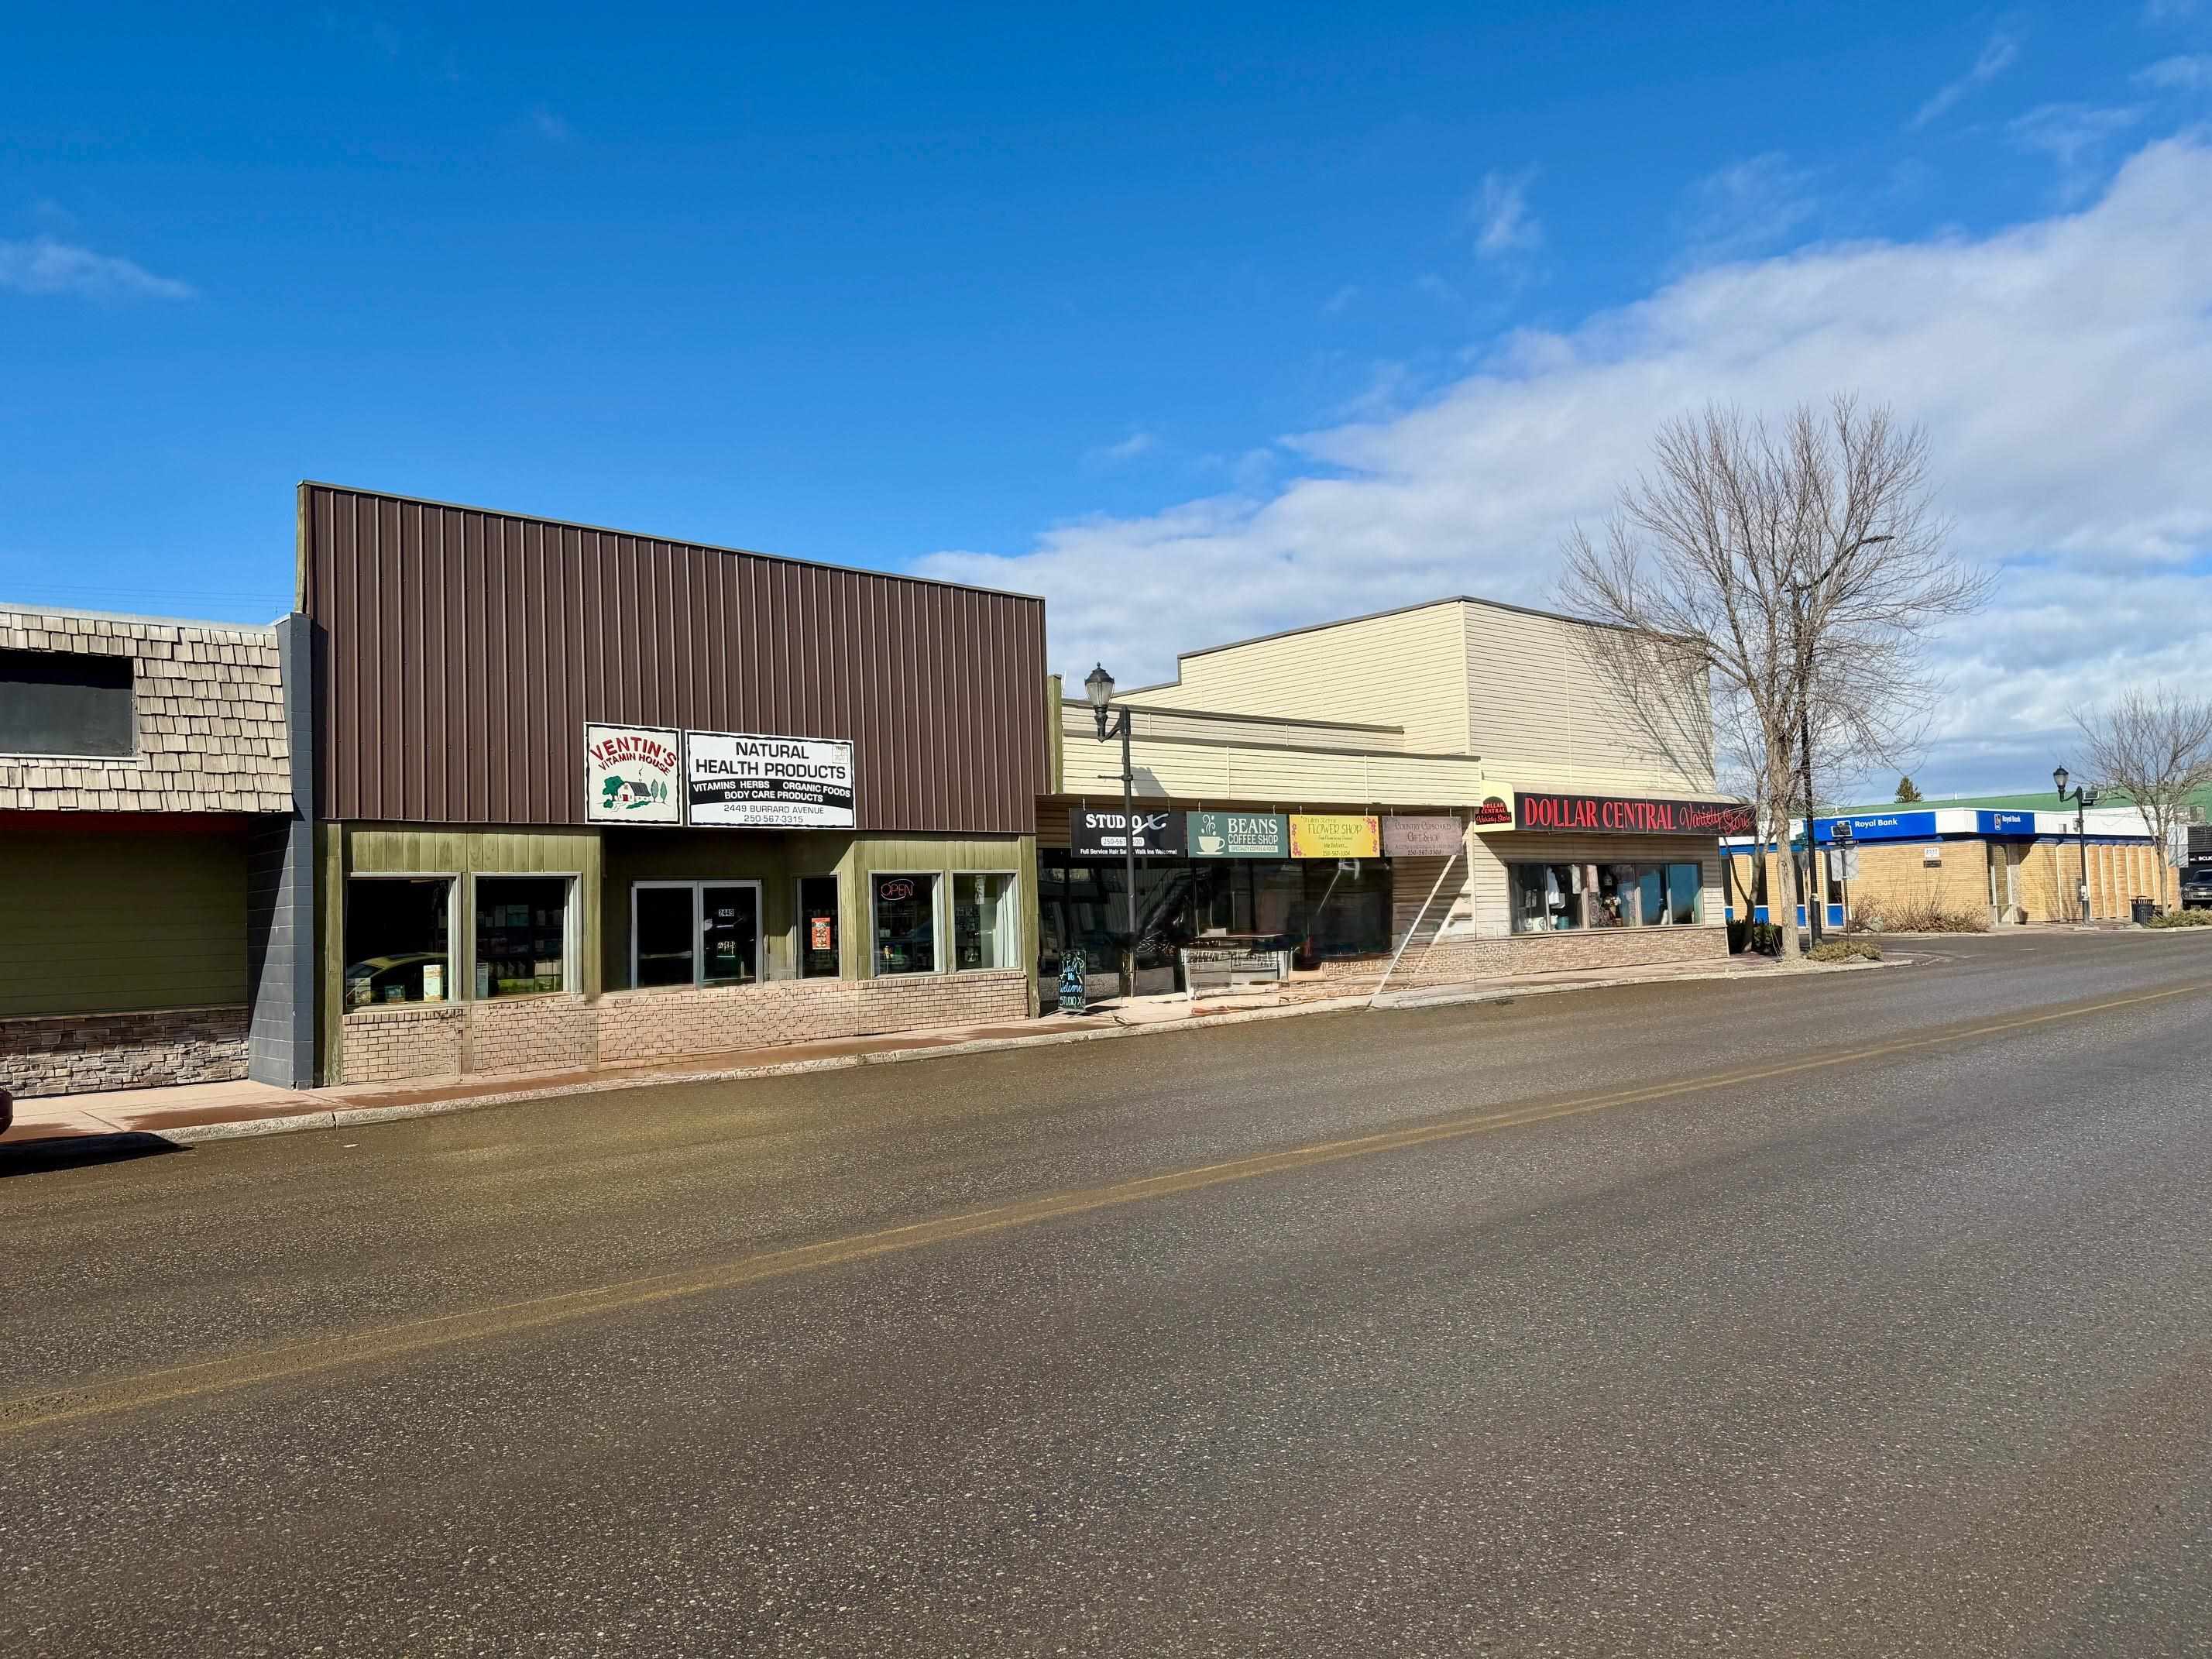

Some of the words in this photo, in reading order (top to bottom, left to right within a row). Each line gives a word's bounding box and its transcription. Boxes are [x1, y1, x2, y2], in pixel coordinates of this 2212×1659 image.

[589, 737, 677, 767] VENTIN'S
[736, 742, 809, 759] NATURAL
[598, 752, 636, 771] VITAMIN
[638, 754, 671, 776] HOUSE
[696, 758, 759, 775] HEALTH
[764, 763, 846, 779] PRODUCTS
[692, 781, 736, 792] VITAMINS
[782, 781, 822, 792] ORGANIC
[823, 785, 851, 798] FOODS
[724, 790, 750, 799] BODY
[751, 790, 775, 799] CARE
[777, 791, 823, 802] PRODUCTS
[1085, 813, 1142, 829] STUDO
[1524, 797, 1599, 828] DOLLAR
[1602, 801, 1677, 830] CENTRAL
[1679, 802, 1721, 830] Variety
[1228, 818, 1278, 834] BEANS
[1308, 823, 1340, 834] FLOWER
[1341, 824, 1362, 834] SHOP
[1855, 819, 1876, 829] Royal
[1877, 818, 1898, 826] Bank
[1228, 833, 1257, 844] COFFEE
[1258, 834, 1278, 845] SHOP
[881, 883, 913, 896] OPEN
[1060, 996, 1077, 1005] STUDIO
